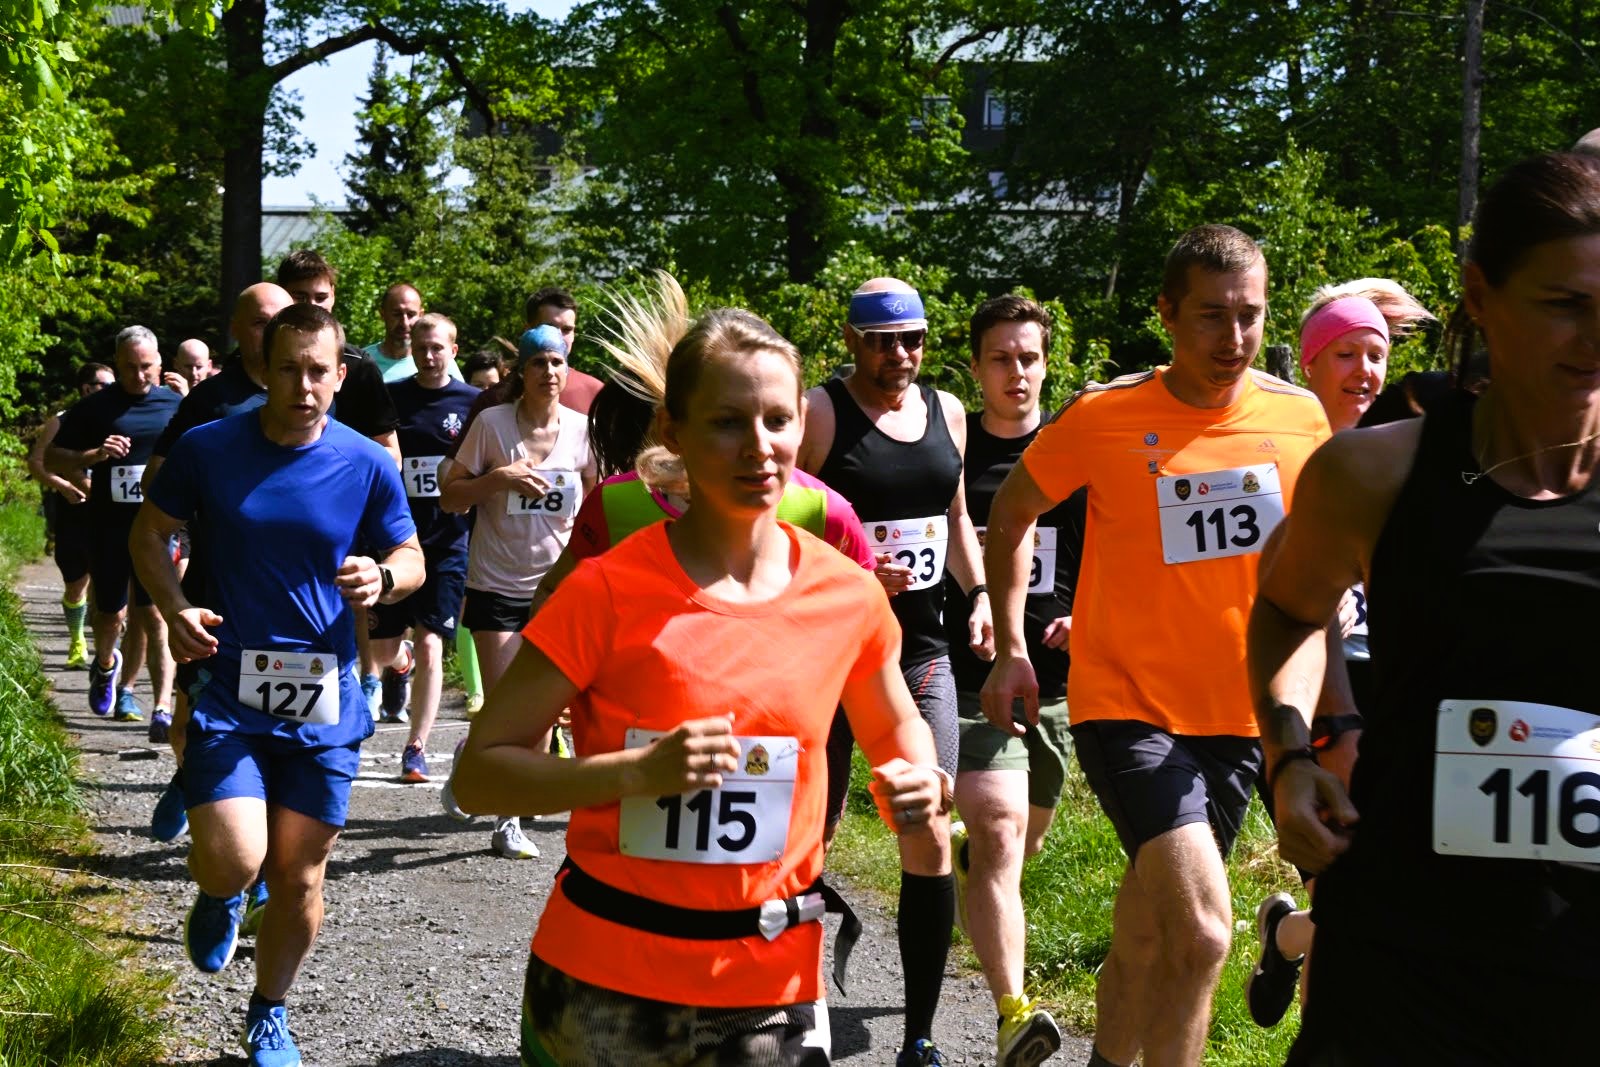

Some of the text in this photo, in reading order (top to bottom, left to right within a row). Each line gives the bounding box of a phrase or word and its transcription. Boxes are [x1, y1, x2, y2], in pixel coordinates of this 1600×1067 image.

[1186, 504, 1261, 553] 113
[884, 547, 936, 582] 23
[256, 681, 325, 718] 127
[656, 789, 757, 852] 115
[1478, 768, 1600, 849] 116
